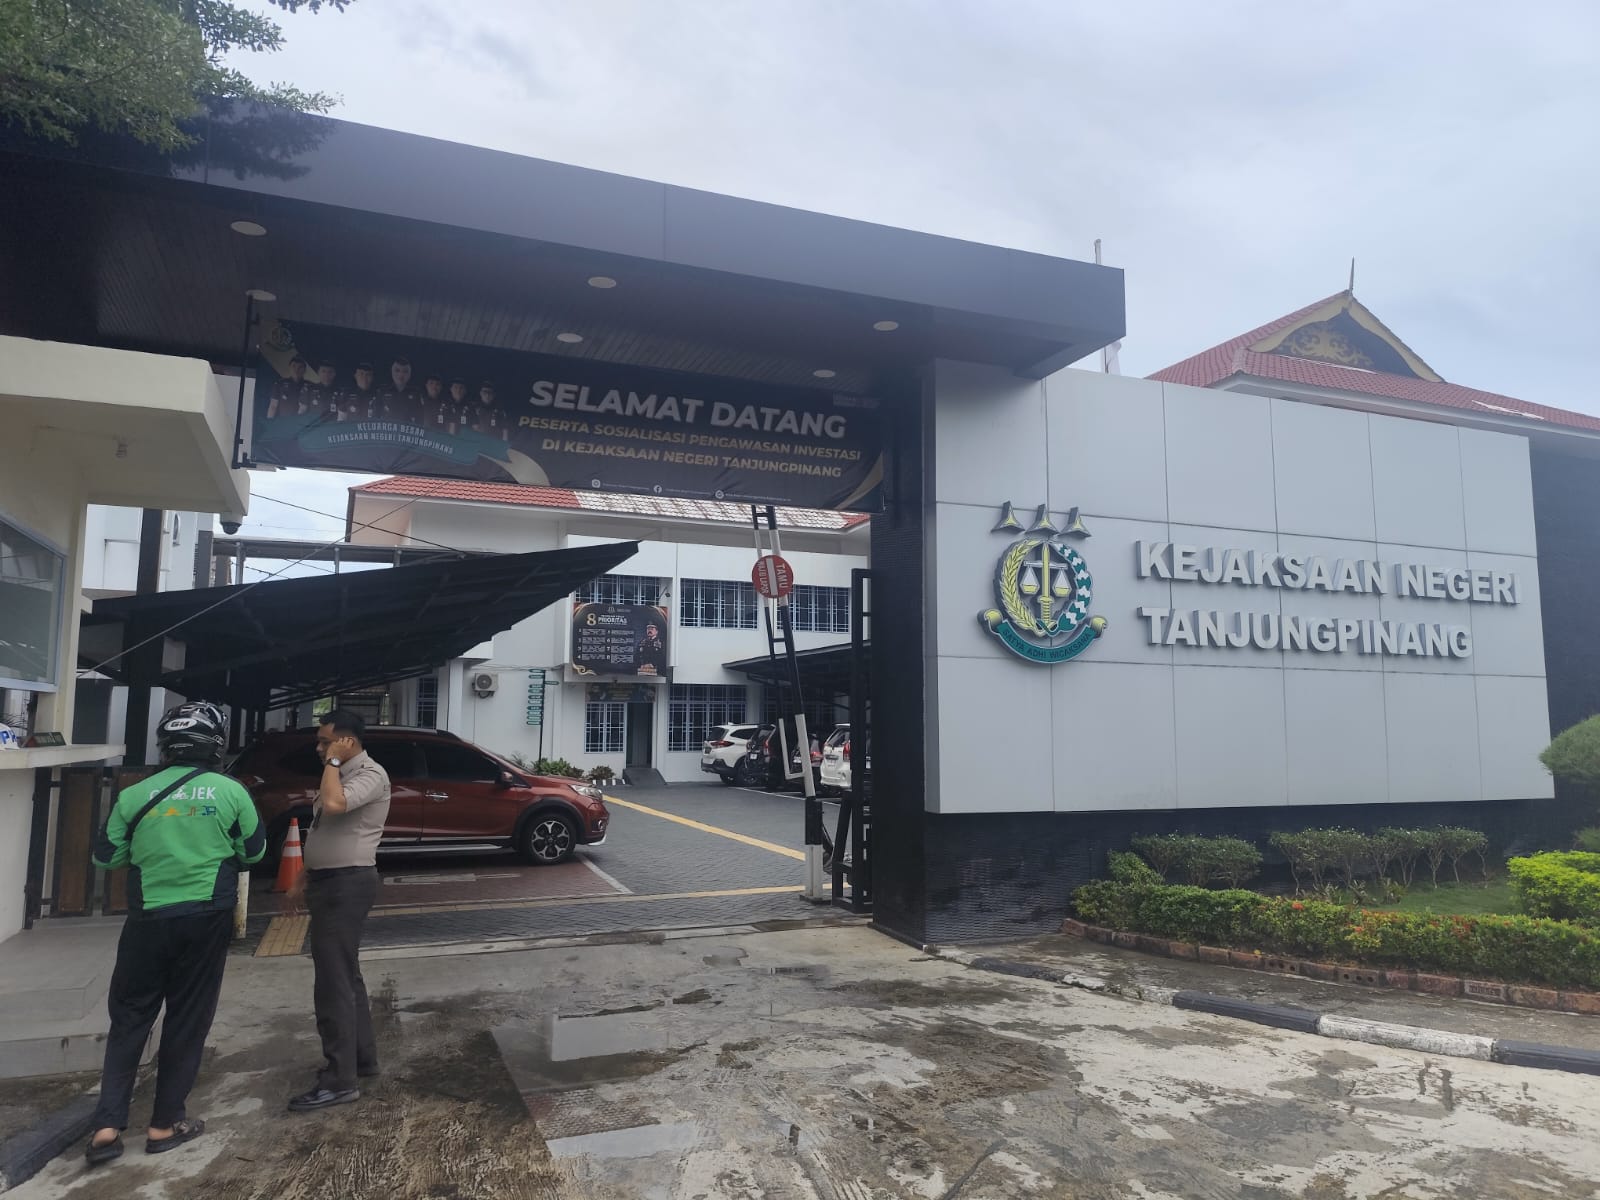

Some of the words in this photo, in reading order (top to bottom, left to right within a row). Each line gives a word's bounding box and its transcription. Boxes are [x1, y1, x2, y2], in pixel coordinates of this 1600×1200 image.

[529, 380, 704, 424] SELAMAT
[710, 401, 847, 439] DATANG
[518, 415, 590, 434] PESERTA
[593, 423, 686, 445] SOSIALISASI
[689, 434, 791, 454] PENGAWASAN
[793, 444, 862, 461] INVESTASI
[542, 438, 560, 452] DI
[564, 440, 661, 462] KEJAKSAAN
[663, 450, 719, 467] NEGERI
[722, 456, 842, 478] TANJUNGPINANG
[776, 563, 789, 588] TAMU
[1136, 540, 1388, 595] KEJAKSAAN
[1395, 562, 1521, 605] NEGERI
[587, 613, 597, 626] 8
[1137, 606, 1473, 659] TANJUNGPINANG
[1026, 648, 1046, 659] ADHI
[171, 720, 190, 728] GM
[190, 786, 217, 801] JEK
